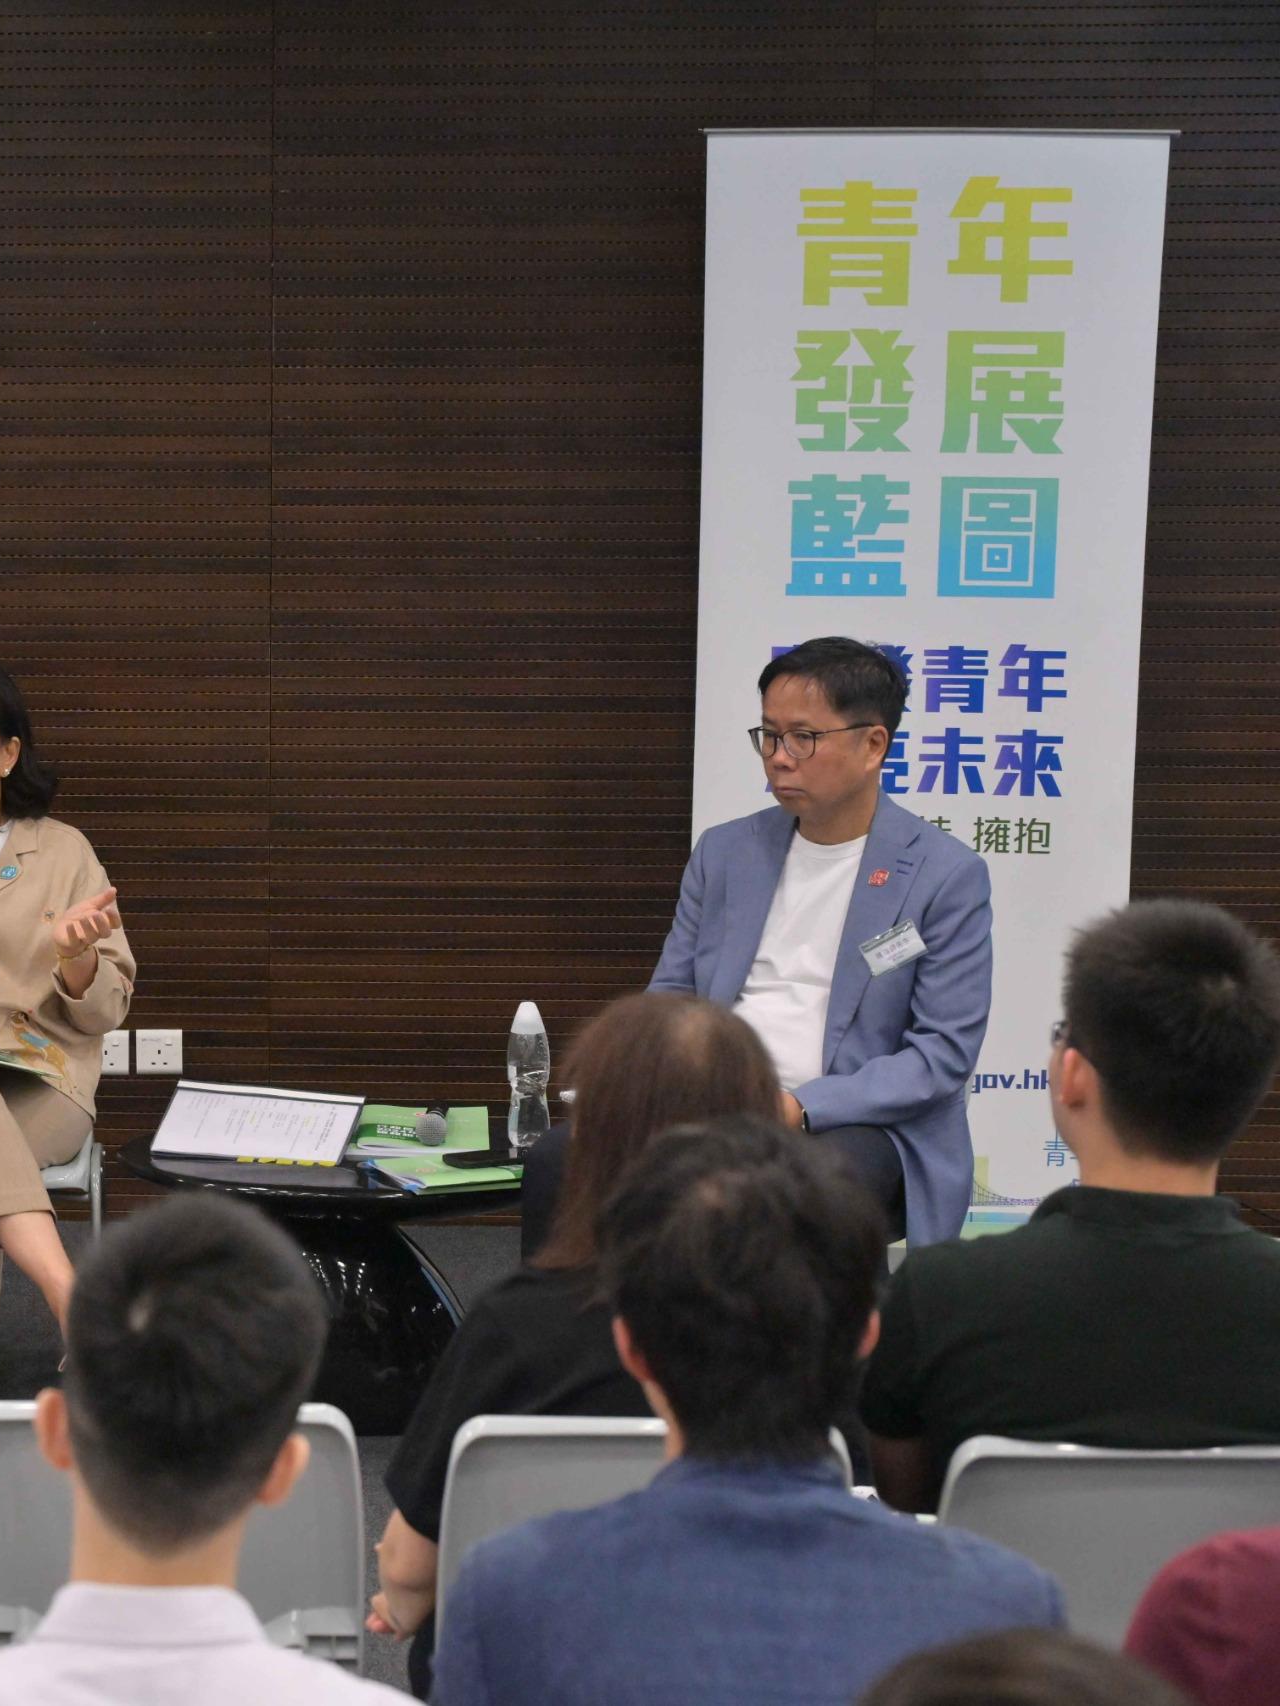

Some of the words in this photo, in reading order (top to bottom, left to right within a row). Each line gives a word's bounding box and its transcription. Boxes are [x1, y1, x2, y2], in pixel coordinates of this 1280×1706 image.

[796, 176, 1073, 306] 青年
[790, 327, 1066, 454] 發展
[785, 473, 1060, 599] 藍圖
[972, 816, 1051, 855] 擁抱
[1043, 1130, 1077, 1167] 青
